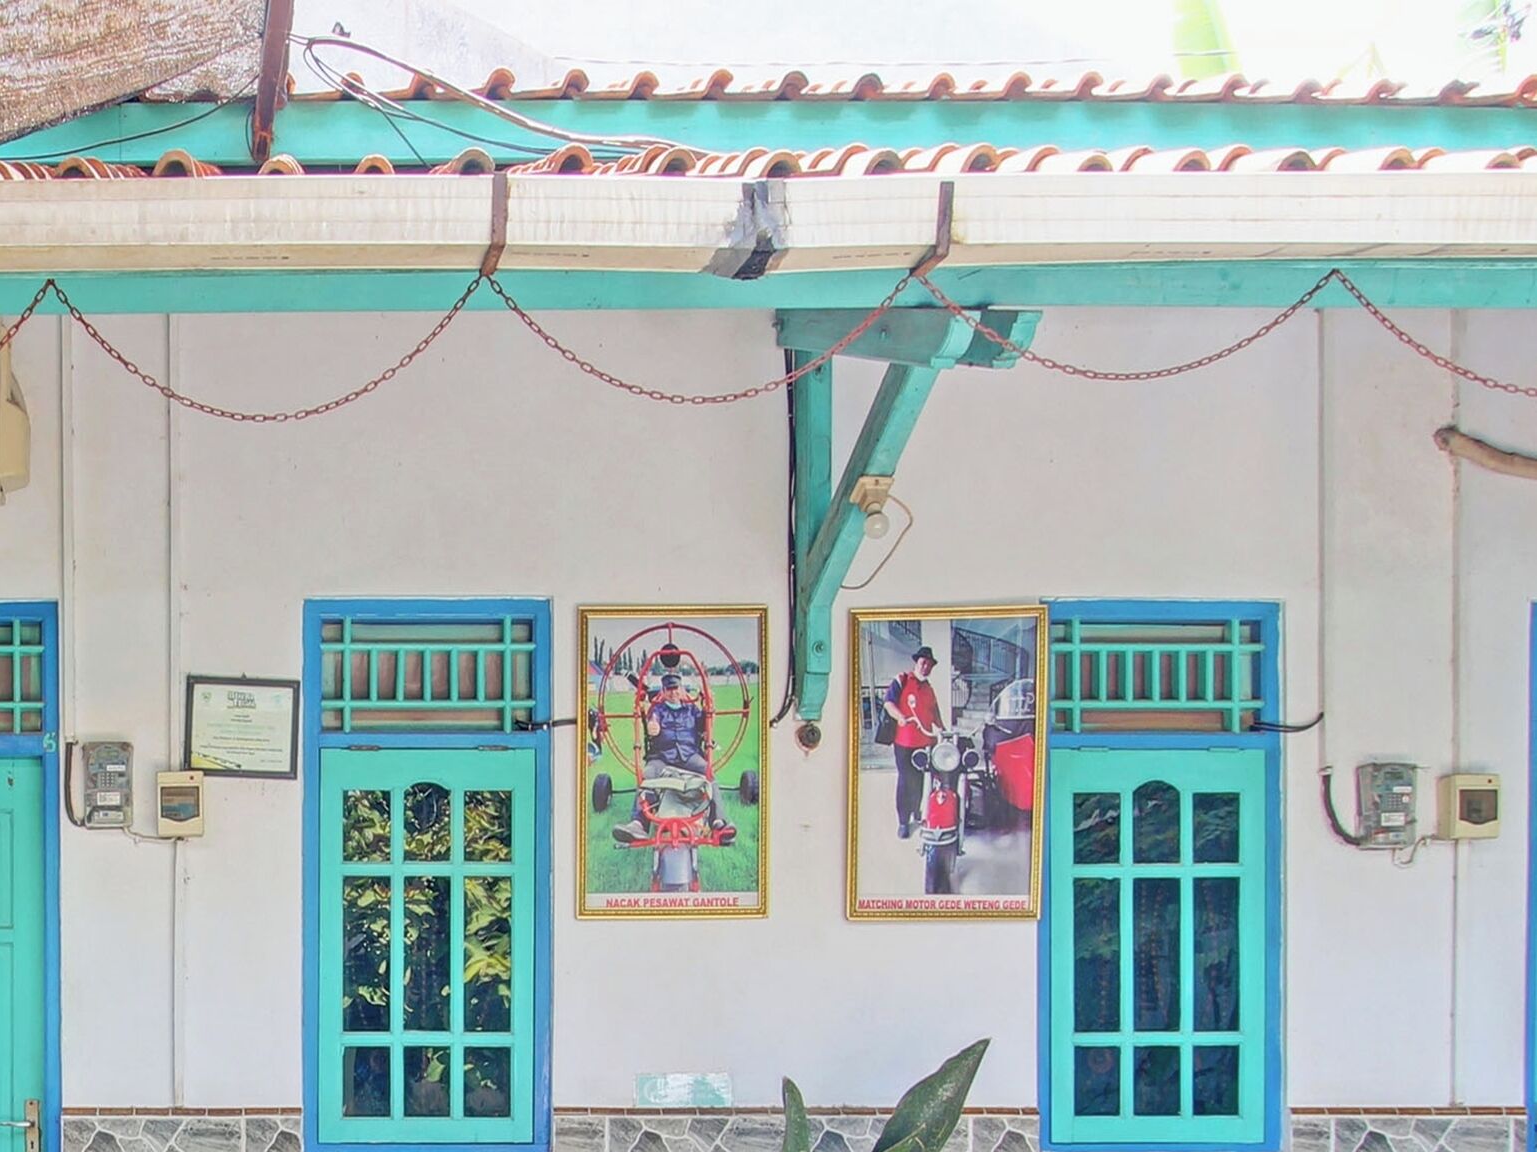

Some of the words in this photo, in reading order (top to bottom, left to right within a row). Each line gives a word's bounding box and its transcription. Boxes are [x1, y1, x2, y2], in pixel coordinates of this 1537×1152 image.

[606, 898, 640, 908] NACAK
[643, 898, 689, 907] PESAWAT
[692, 897, 740, 907] GANTOLE
[858, 900, 904, 910] MATCHING
[905, 900, 938, 910] MOTOR
[938, 900, 962, 910] GEDE
[963, 900, 1000, 910] WETENG
[1002, 900, 1027, 910] GEDE
